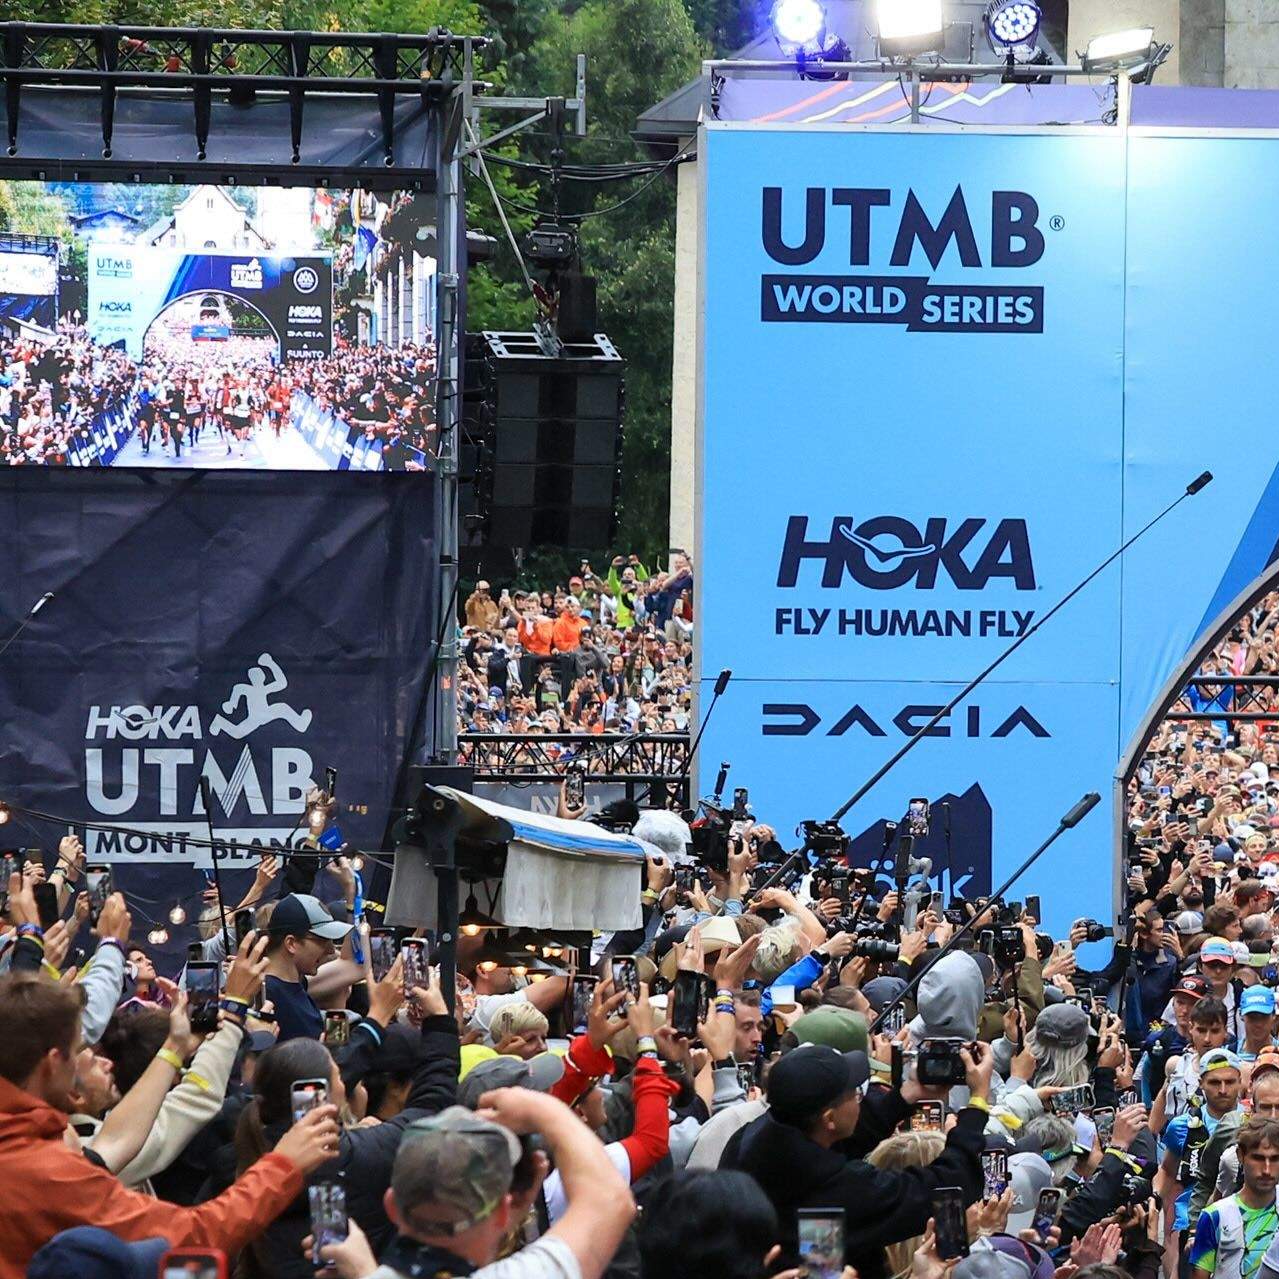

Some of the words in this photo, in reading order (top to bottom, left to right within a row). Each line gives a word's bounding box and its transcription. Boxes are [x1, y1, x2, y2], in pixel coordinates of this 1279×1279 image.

[772, 284, 907, 315] WORLD
[921, 295, 1035, 326] SERIES
[776, 515, 1039, 591] HOKA
[775, 608, 831, 636] FLY
[838, 609, 972, 638] HUMAN
[979, 610, 1036, 638] FLY
[86, 705, 203, 740] HOKA
[762, 703, 1052, 738] DACIA
[86, 742, 315, 819] UTMB
